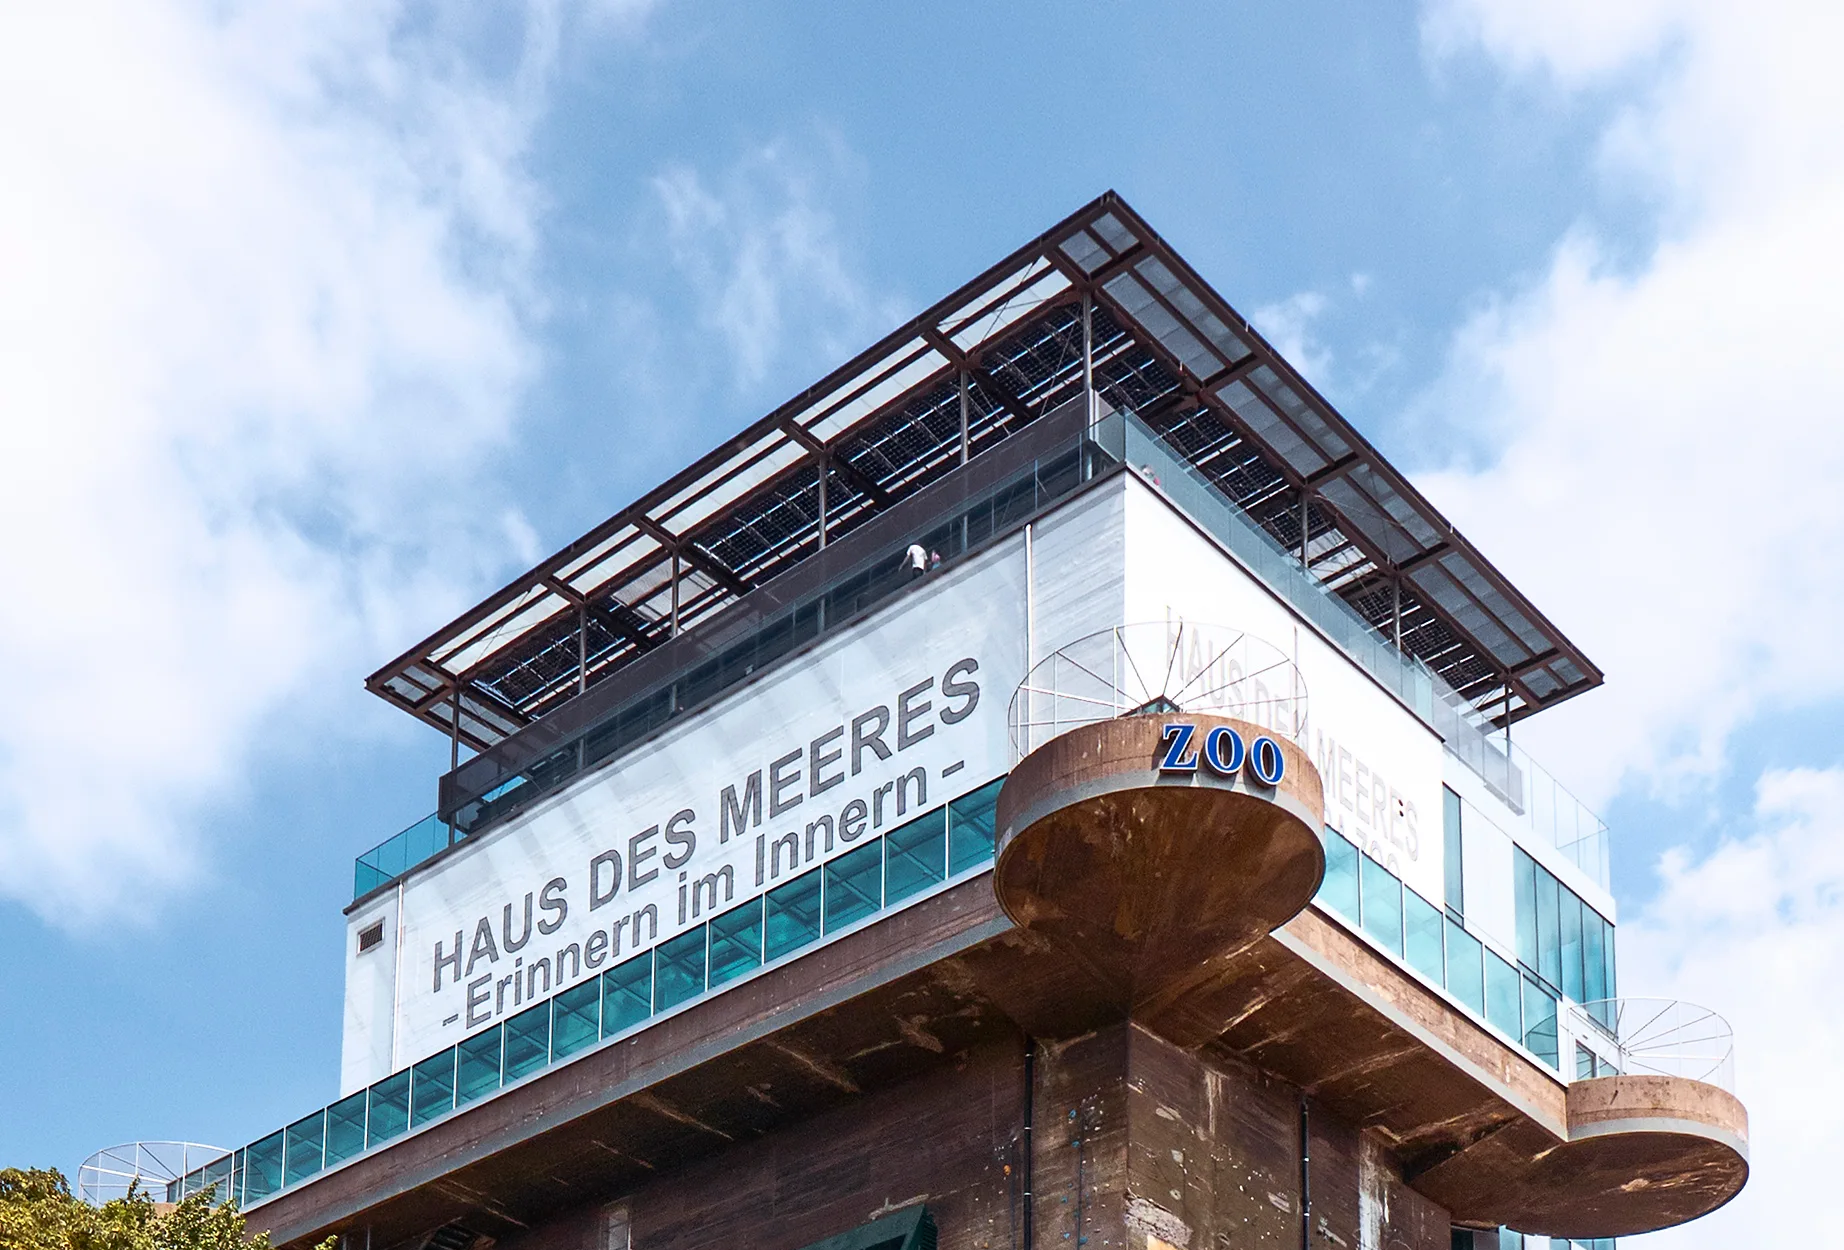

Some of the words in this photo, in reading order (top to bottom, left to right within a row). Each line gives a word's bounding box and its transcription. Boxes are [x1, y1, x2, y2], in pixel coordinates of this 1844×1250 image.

[433, 877, 568, 993] HAUS
[589, 809, 697, 911] DES
[720, 657, 980, 845] MEERES
[1160, 723, 1286, 785] ZOO
[1317, 727, 1419, 862] MEERES
[678, 862, 734, 925] im
[755, 765, 928, 887] Innern
